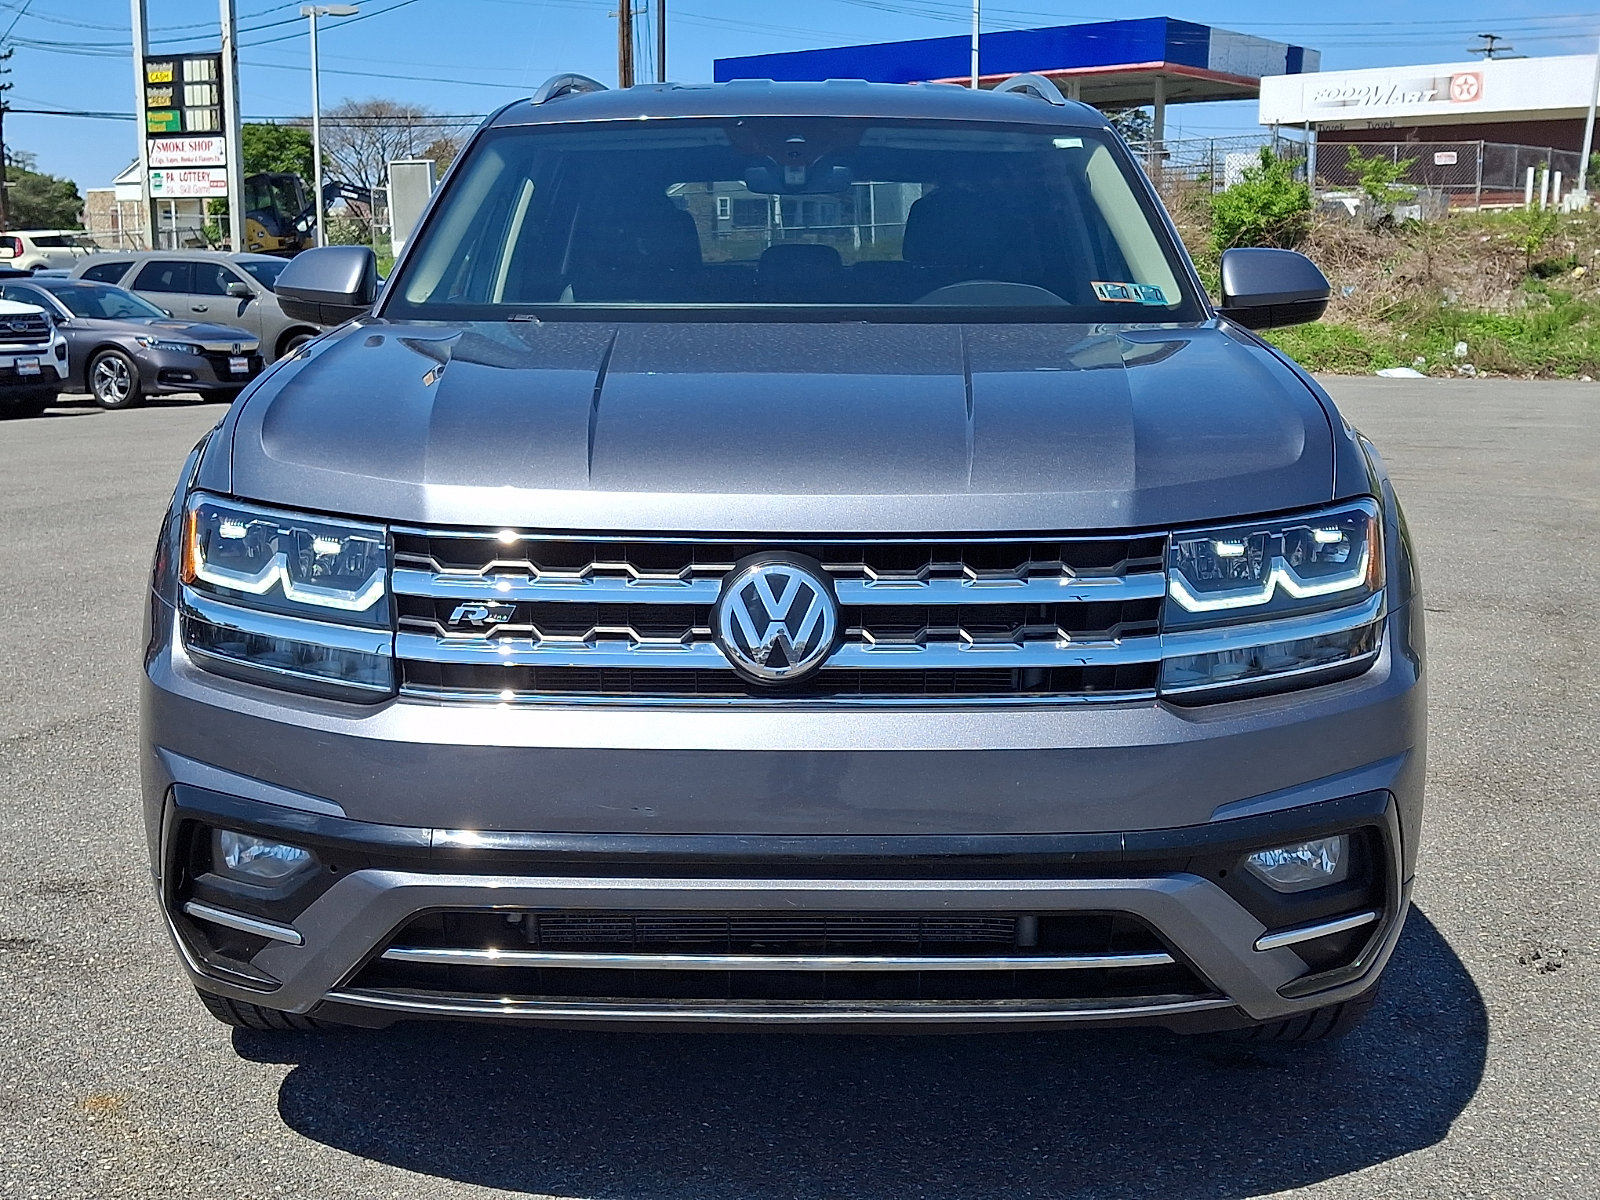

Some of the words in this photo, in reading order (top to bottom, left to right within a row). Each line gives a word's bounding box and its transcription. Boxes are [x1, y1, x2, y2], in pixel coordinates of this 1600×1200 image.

[156, 141, 186, 153] SMOKE
[189, 140, 213, 152] SHOP
[166, 172, 175, 183] PA
[180, 171, 210, 182] LOTTERY
[167, 185, 175, 195] PA
